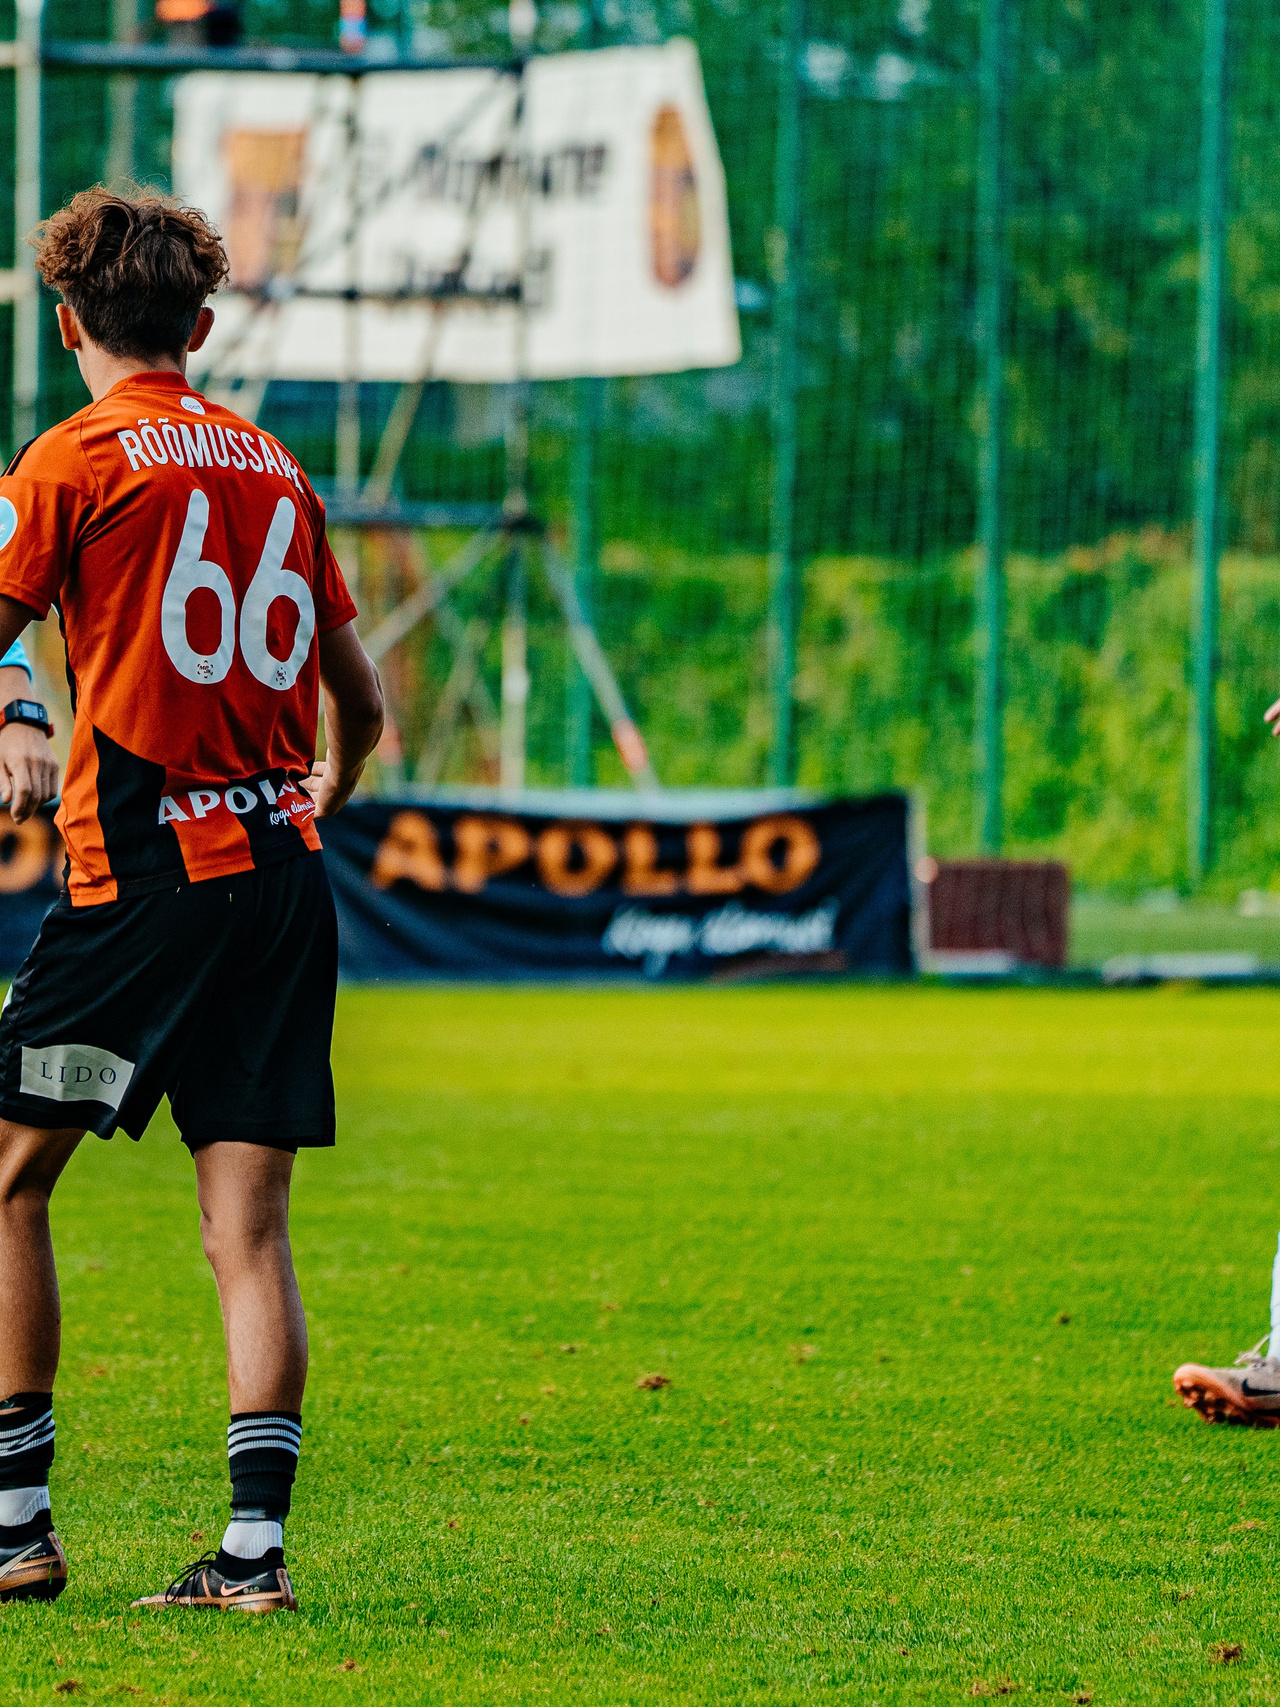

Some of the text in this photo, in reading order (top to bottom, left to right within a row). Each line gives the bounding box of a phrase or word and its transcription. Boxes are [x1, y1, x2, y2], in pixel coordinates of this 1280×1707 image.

[161, 488, 315, 691] 66
[372, 810, 819, 897] APOLLO
[40, 1061, 117, 1085] LIDO
